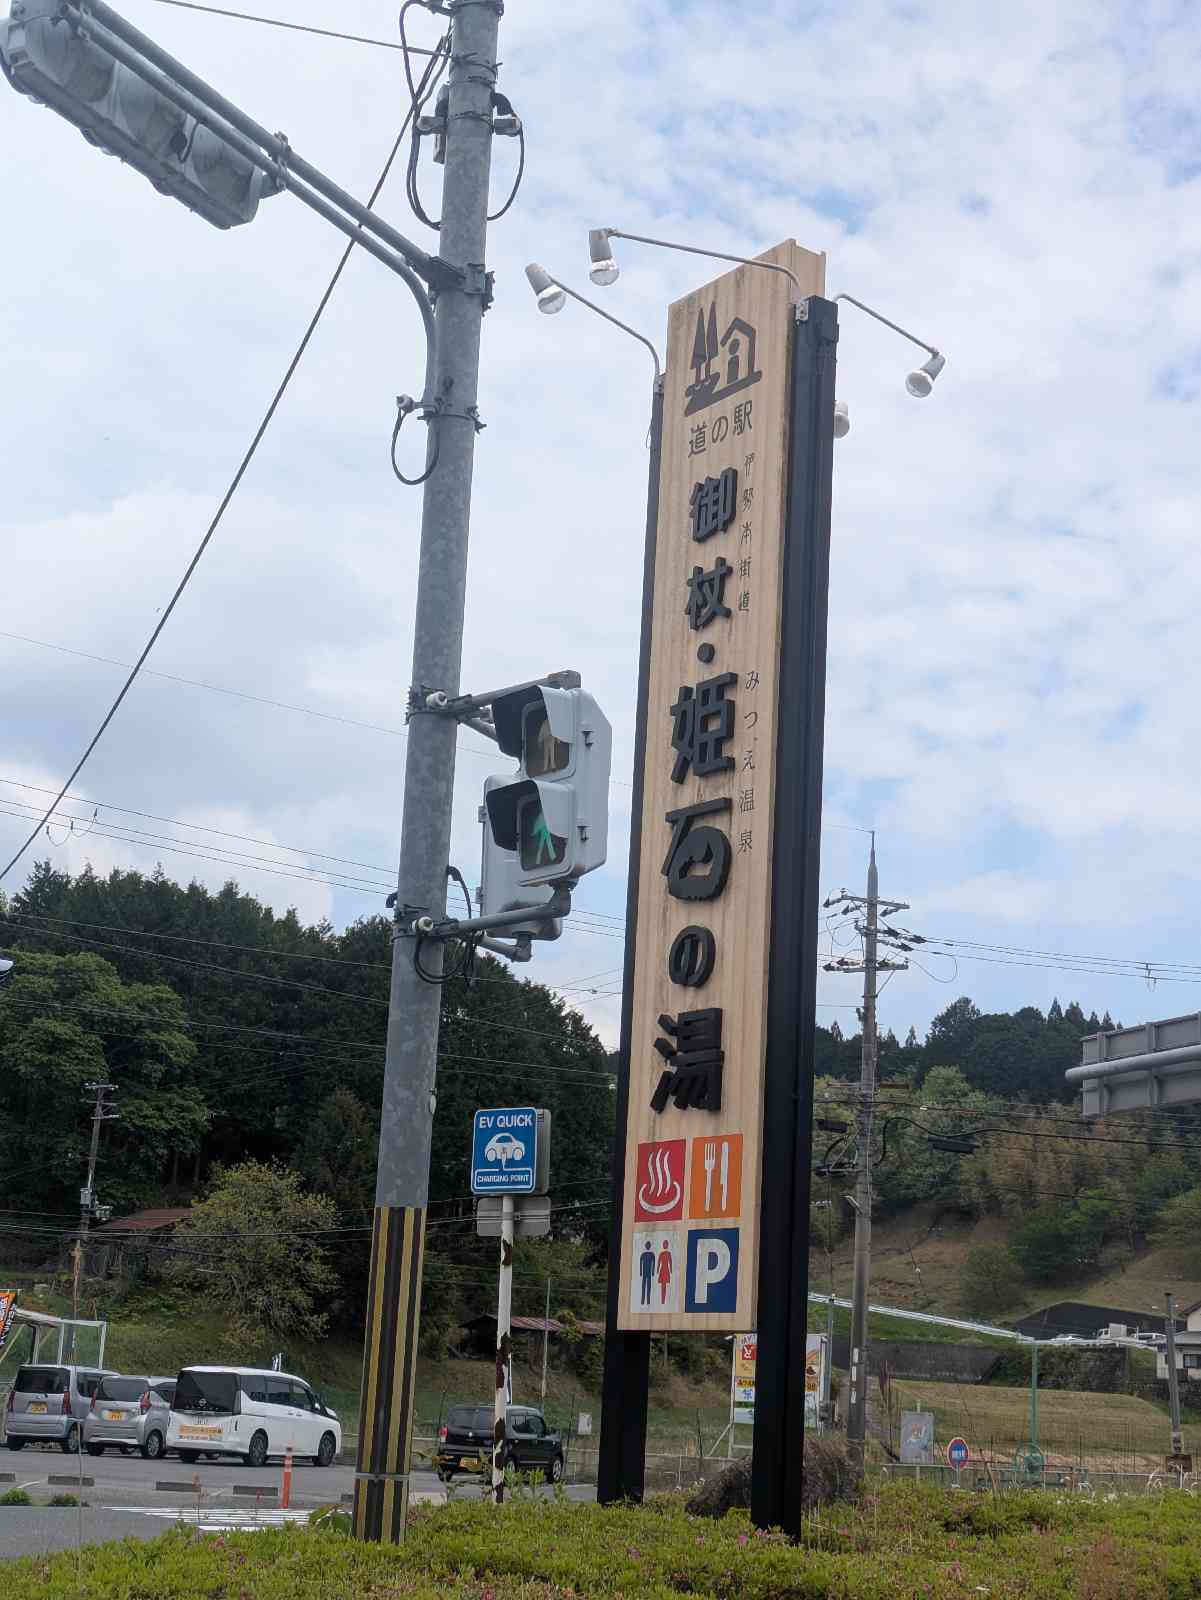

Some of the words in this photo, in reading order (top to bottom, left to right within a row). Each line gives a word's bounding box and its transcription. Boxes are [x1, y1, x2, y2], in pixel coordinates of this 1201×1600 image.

[687, 400, 753, 459] 道の駅
[736, 452, 757, 612] 伊勢本街道
[736, 670, 760, 855] みつえ温泉
[479, 1116, 495, 1129] EV
[496, 1114, 533, 1128] QUICK
[510, 1174, 530, 1182] POINT
[694, 1238, 732, 1305] P
